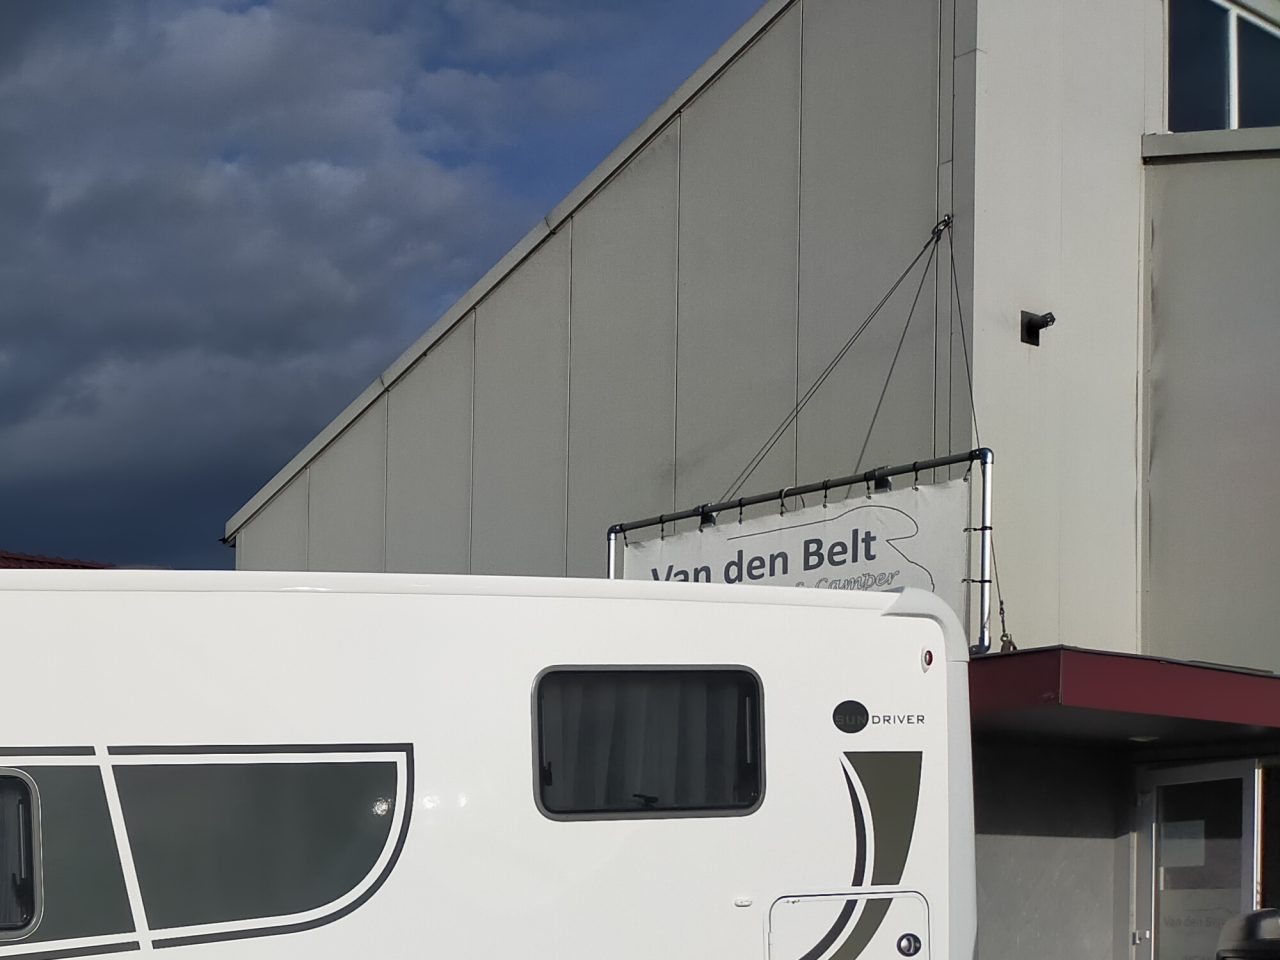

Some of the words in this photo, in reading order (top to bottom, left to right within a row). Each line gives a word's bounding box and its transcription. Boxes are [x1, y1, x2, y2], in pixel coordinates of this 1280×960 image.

[723, 549, 789, 585] den
[803, 528, 877, 572] Belt
[871, 714, 926, 725] DRIVER
